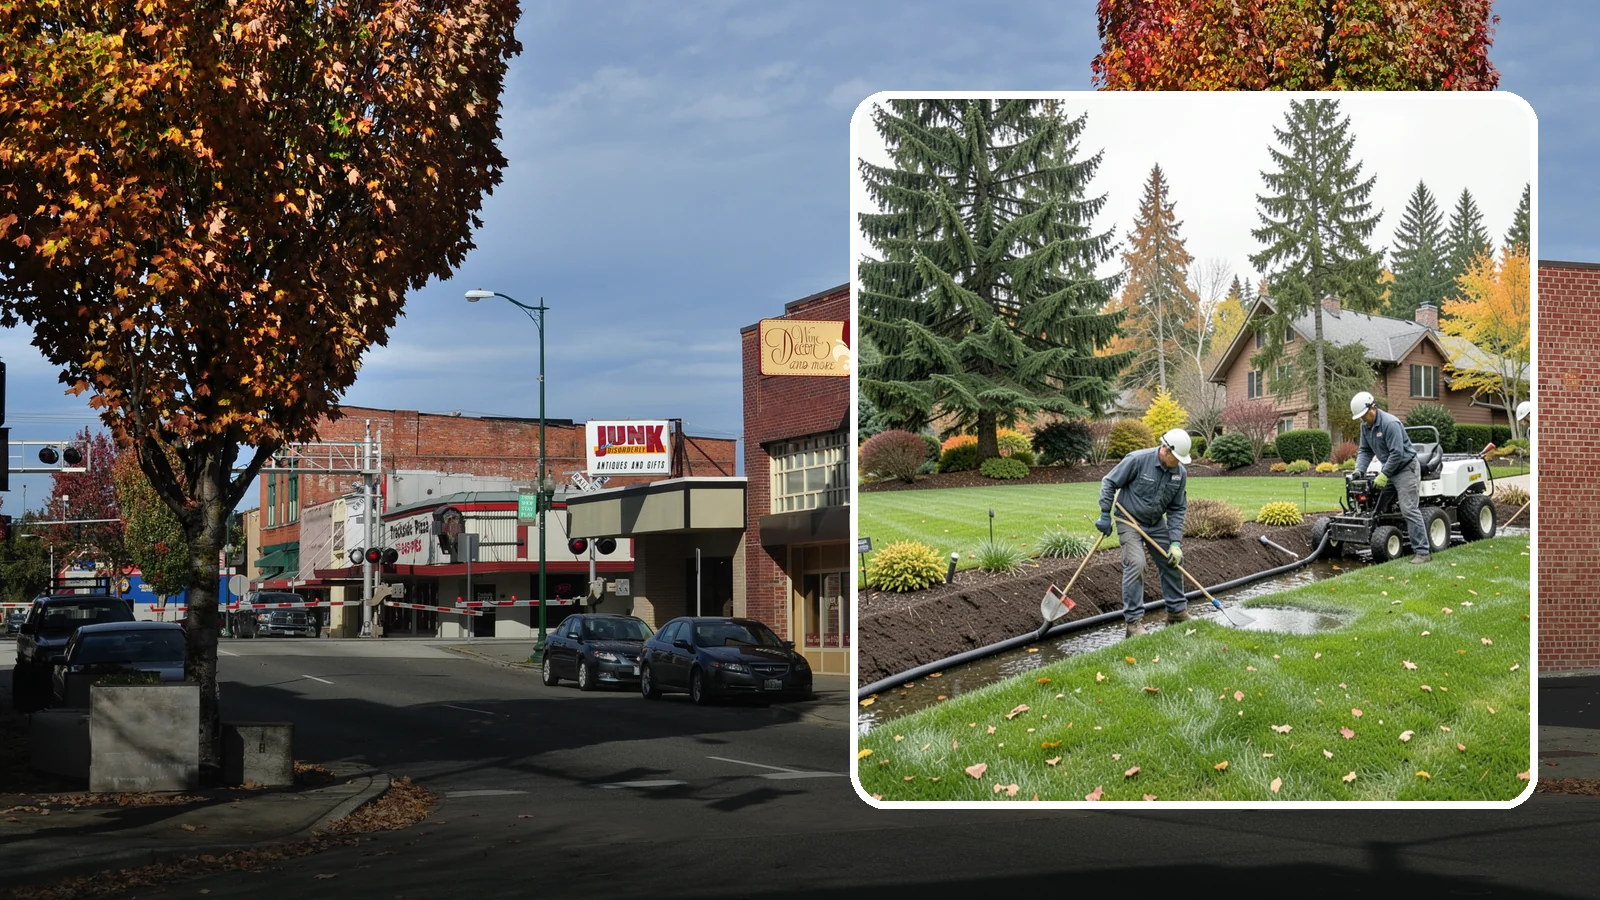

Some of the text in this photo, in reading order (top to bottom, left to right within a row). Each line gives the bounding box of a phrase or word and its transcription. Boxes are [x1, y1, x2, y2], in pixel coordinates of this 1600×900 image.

[595, 425, 666, 457] JUNK
[607, 446, 646, 454] DISORDERLY
[596, 460, 665, 470] ANTIQUES AND GIFTS
[414, 519, 429, 535] Pizza
